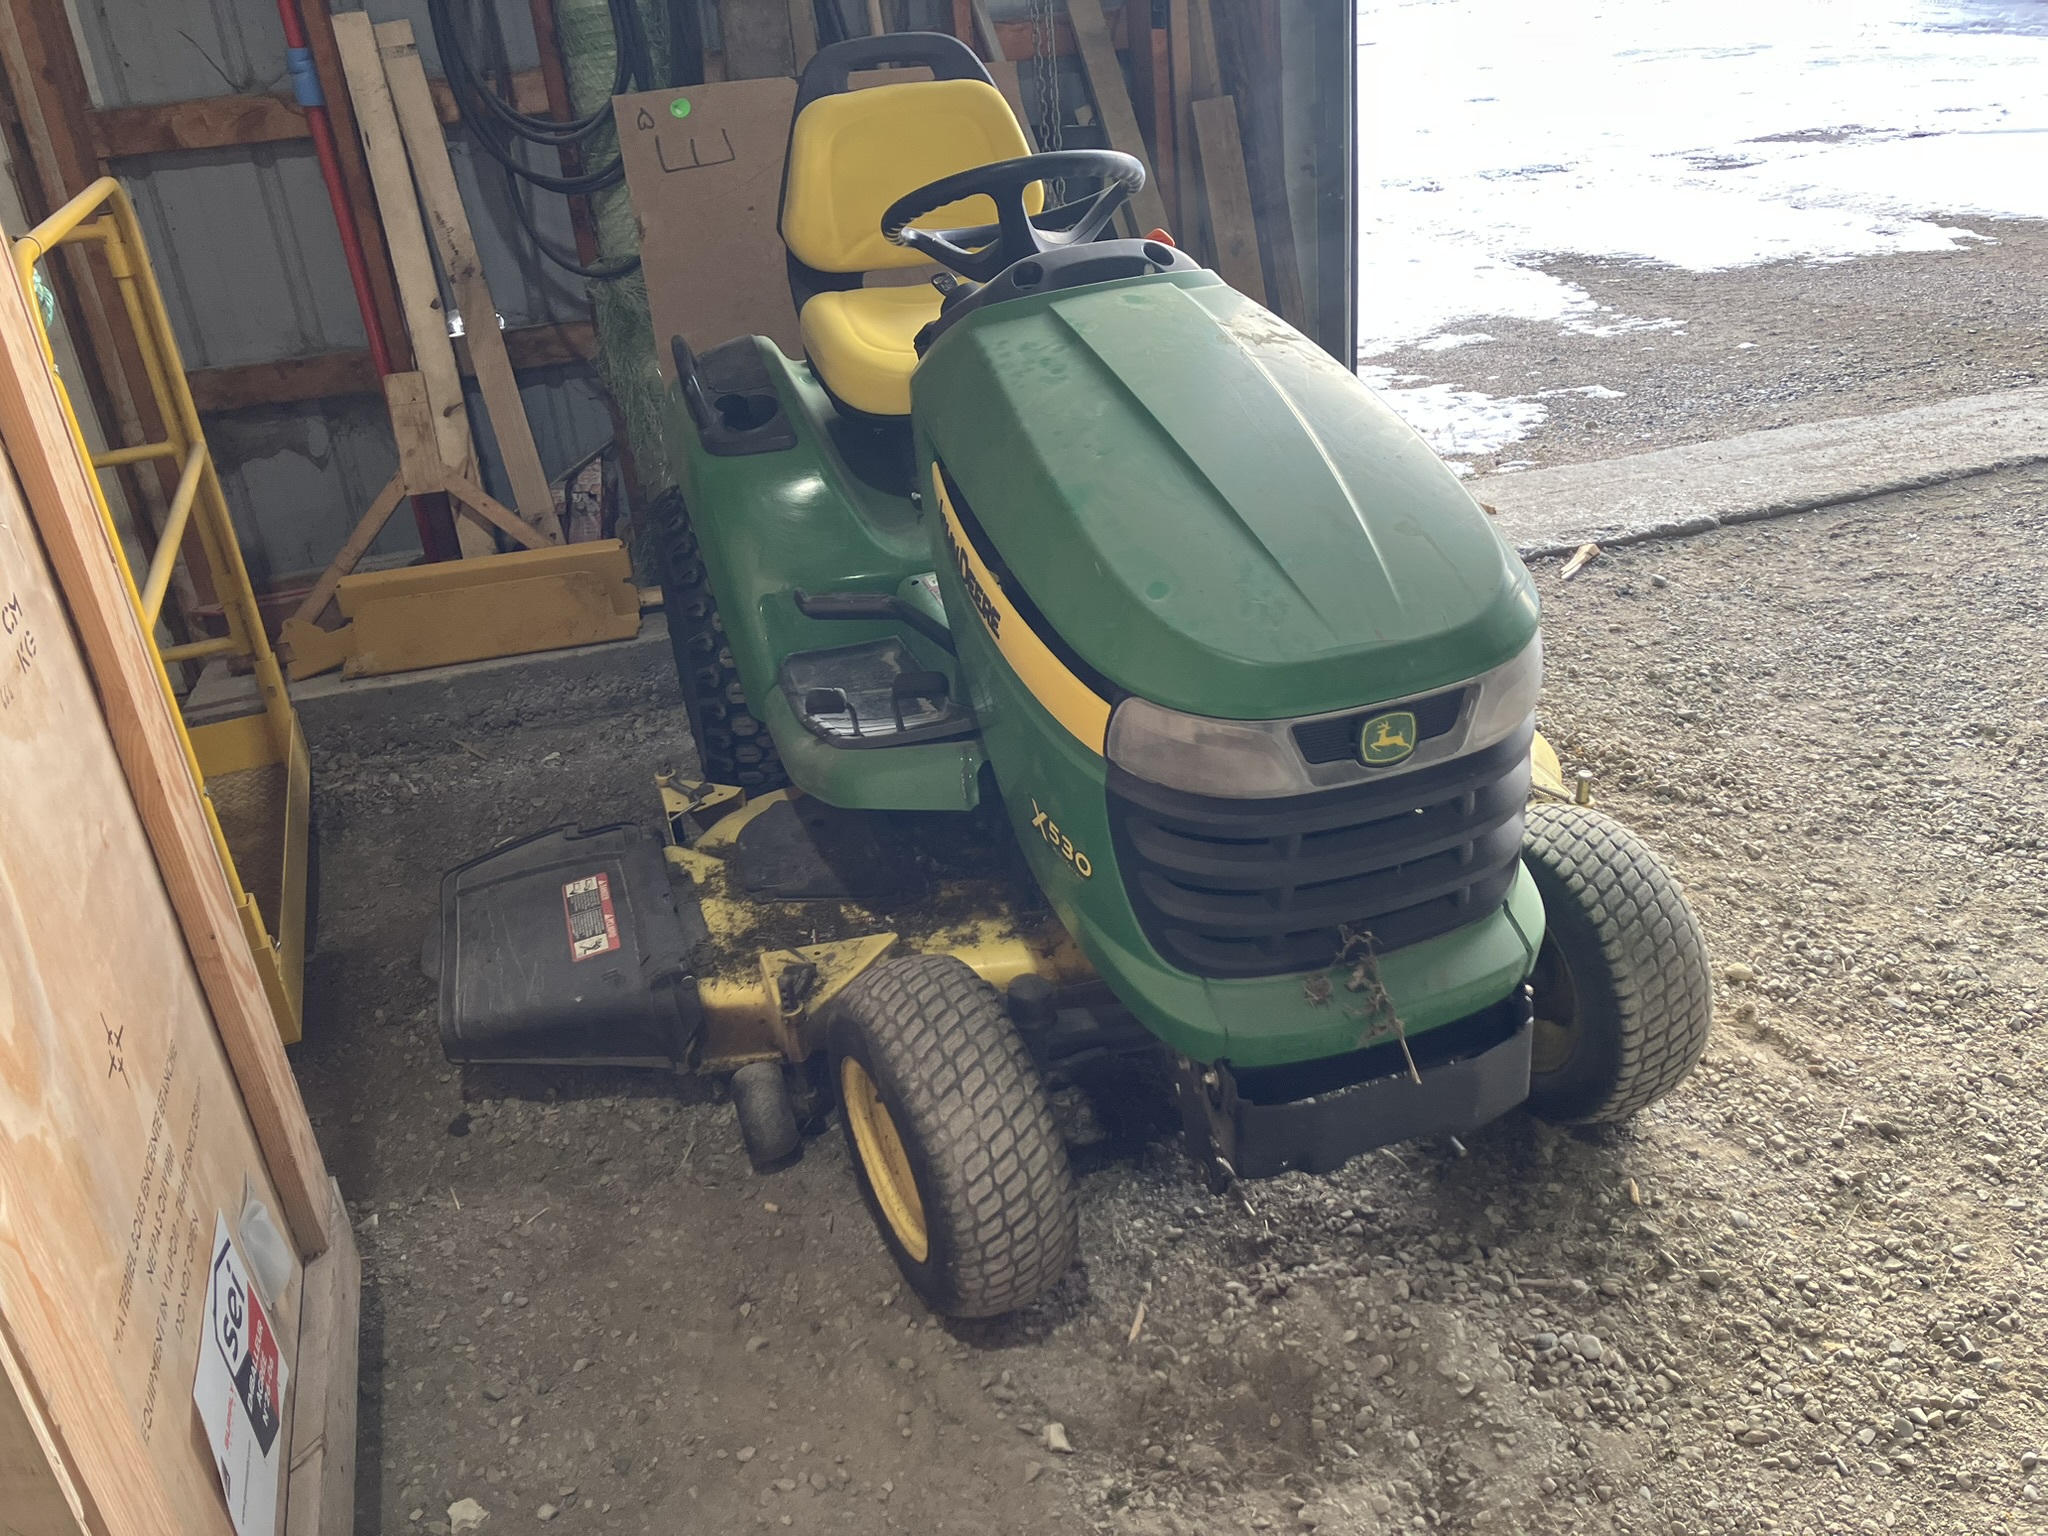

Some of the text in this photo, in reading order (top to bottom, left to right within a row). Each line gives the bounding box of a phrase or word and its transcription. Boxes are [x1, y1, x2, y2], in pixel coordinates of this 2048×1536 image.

[2, 592, 23, 635] CM
[961, 546, 1001, 641] DEERE
[1031, 797, 1093, 879] X530
[113, 1039, 178, 1353] MATERIEL SOUS ENCEINTE ETANCHE
[146, 1143, 175, 1285] NE PAS OUVRIR
[175, 1209, 200, 1341] DO NOT OPEN
[223, 1259, 245, 1363] sei
[141, 1316, 166, 1446] EQUIPMENT
[160, 1292, 168, 1322] IN
[247, 1319, 264, 1414] EMBALLEUR
